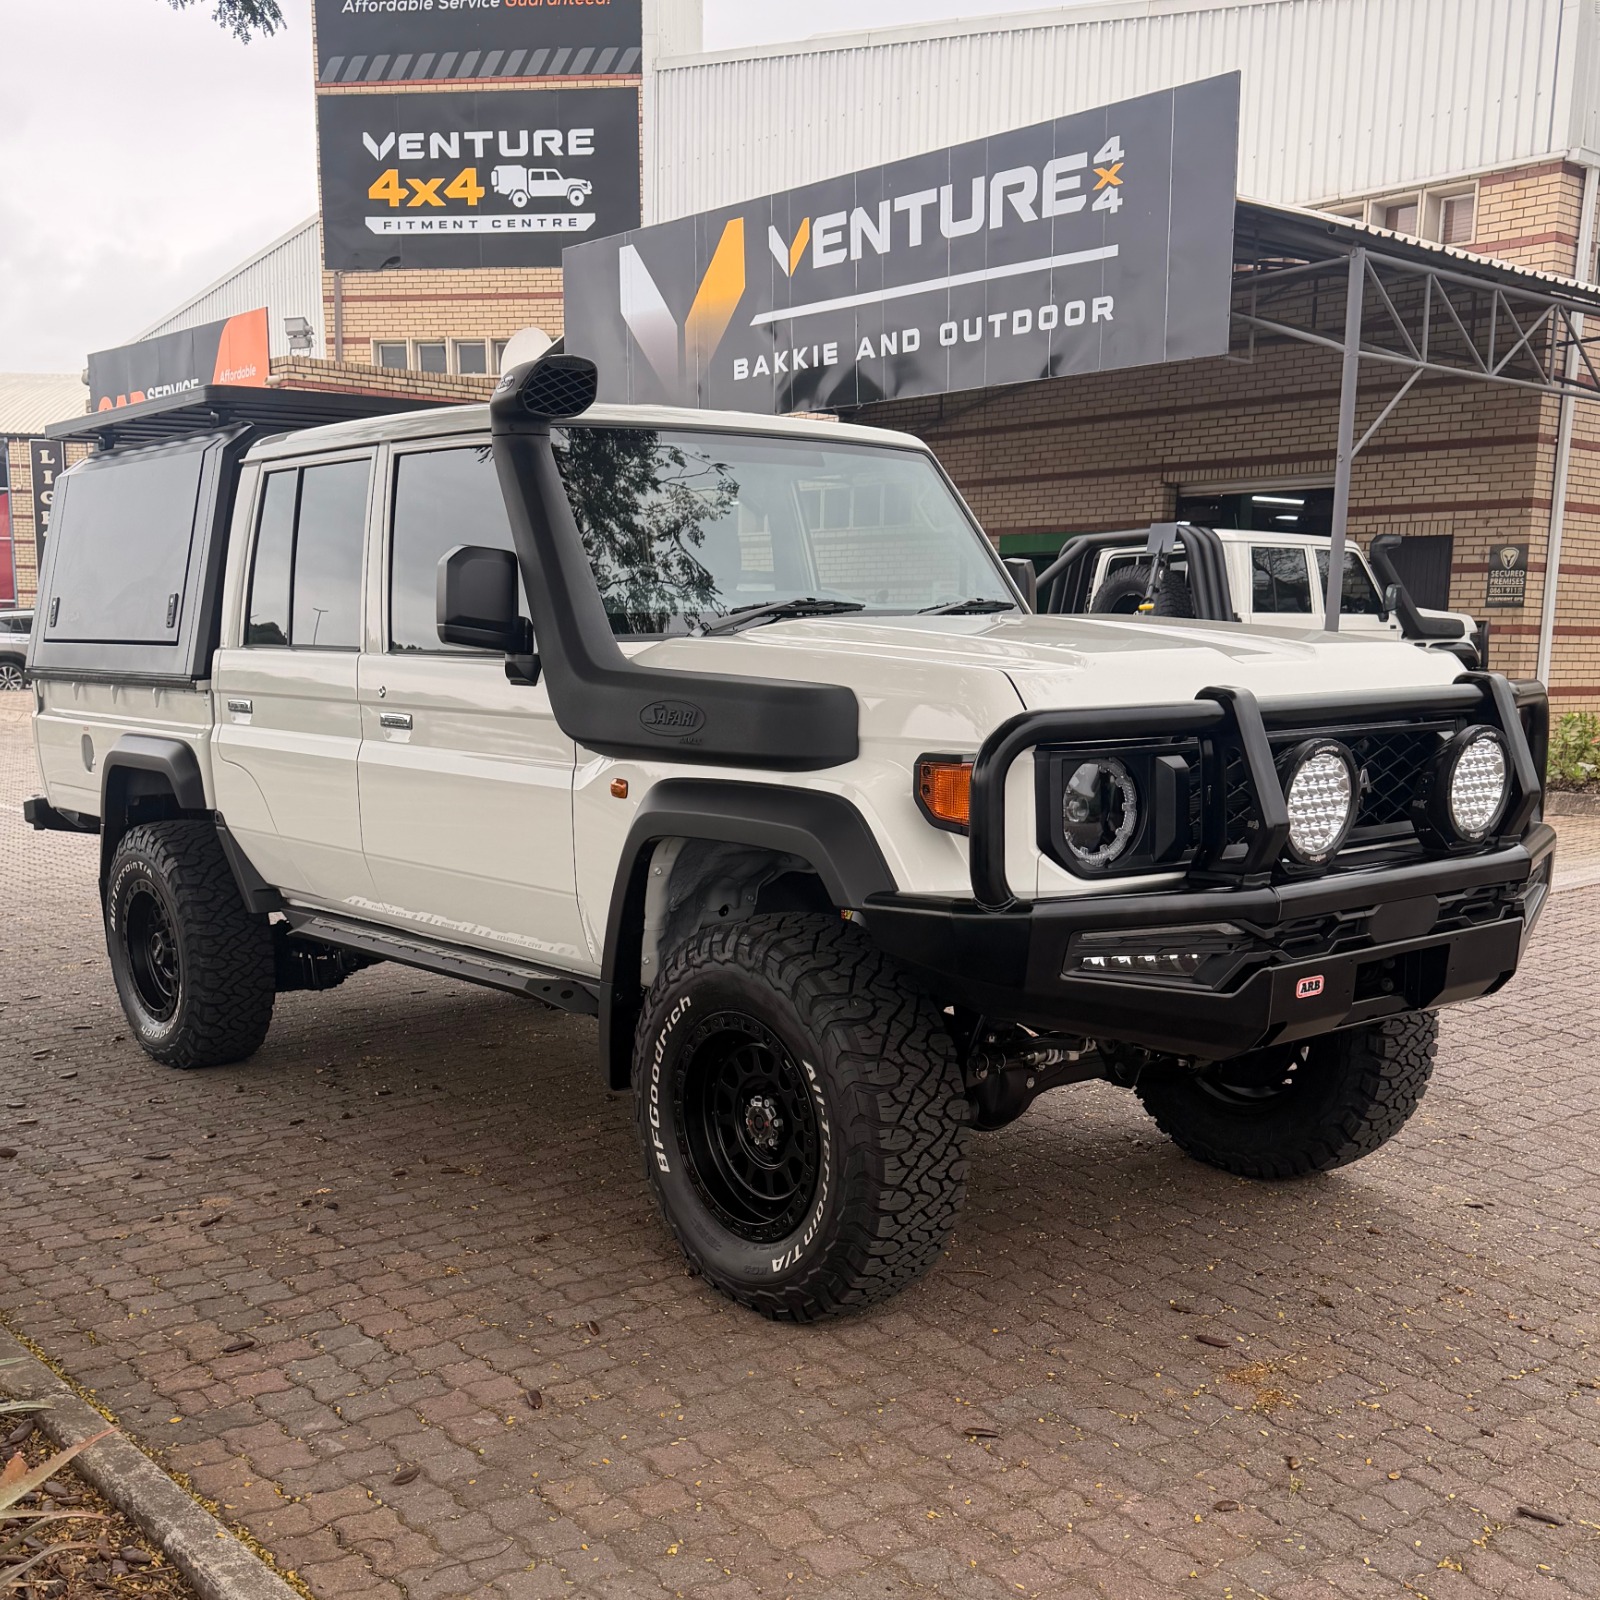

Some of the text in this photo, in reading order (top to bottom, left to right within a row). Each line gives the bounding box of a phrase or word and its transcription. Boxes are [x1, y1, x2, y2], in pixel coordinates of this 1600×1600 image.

[341, 0, 434, 13] Affordable
[362, 128, 595, 161] VENTURE
[368, 167, 486, 208] 4x4
[383, 218, 578, 230] FITMENT CENTRE
[768, 151, 1088, 278] VENTURE
[733, 295, 1114, 381] BAKKIE AND OUTDOOR
[220, 363, 256, 382] Affordable
[1489, 577, 1524, 585] PREMISES
[1490, 569, 1525, 578] SECURED
[645, 703, 698, 727] SAFARI
[1300, 979, 1321, 994] ARB
[649, 995, 692, 1173] BFGoodrich
[771, 1243, 804, 1273] T/A
